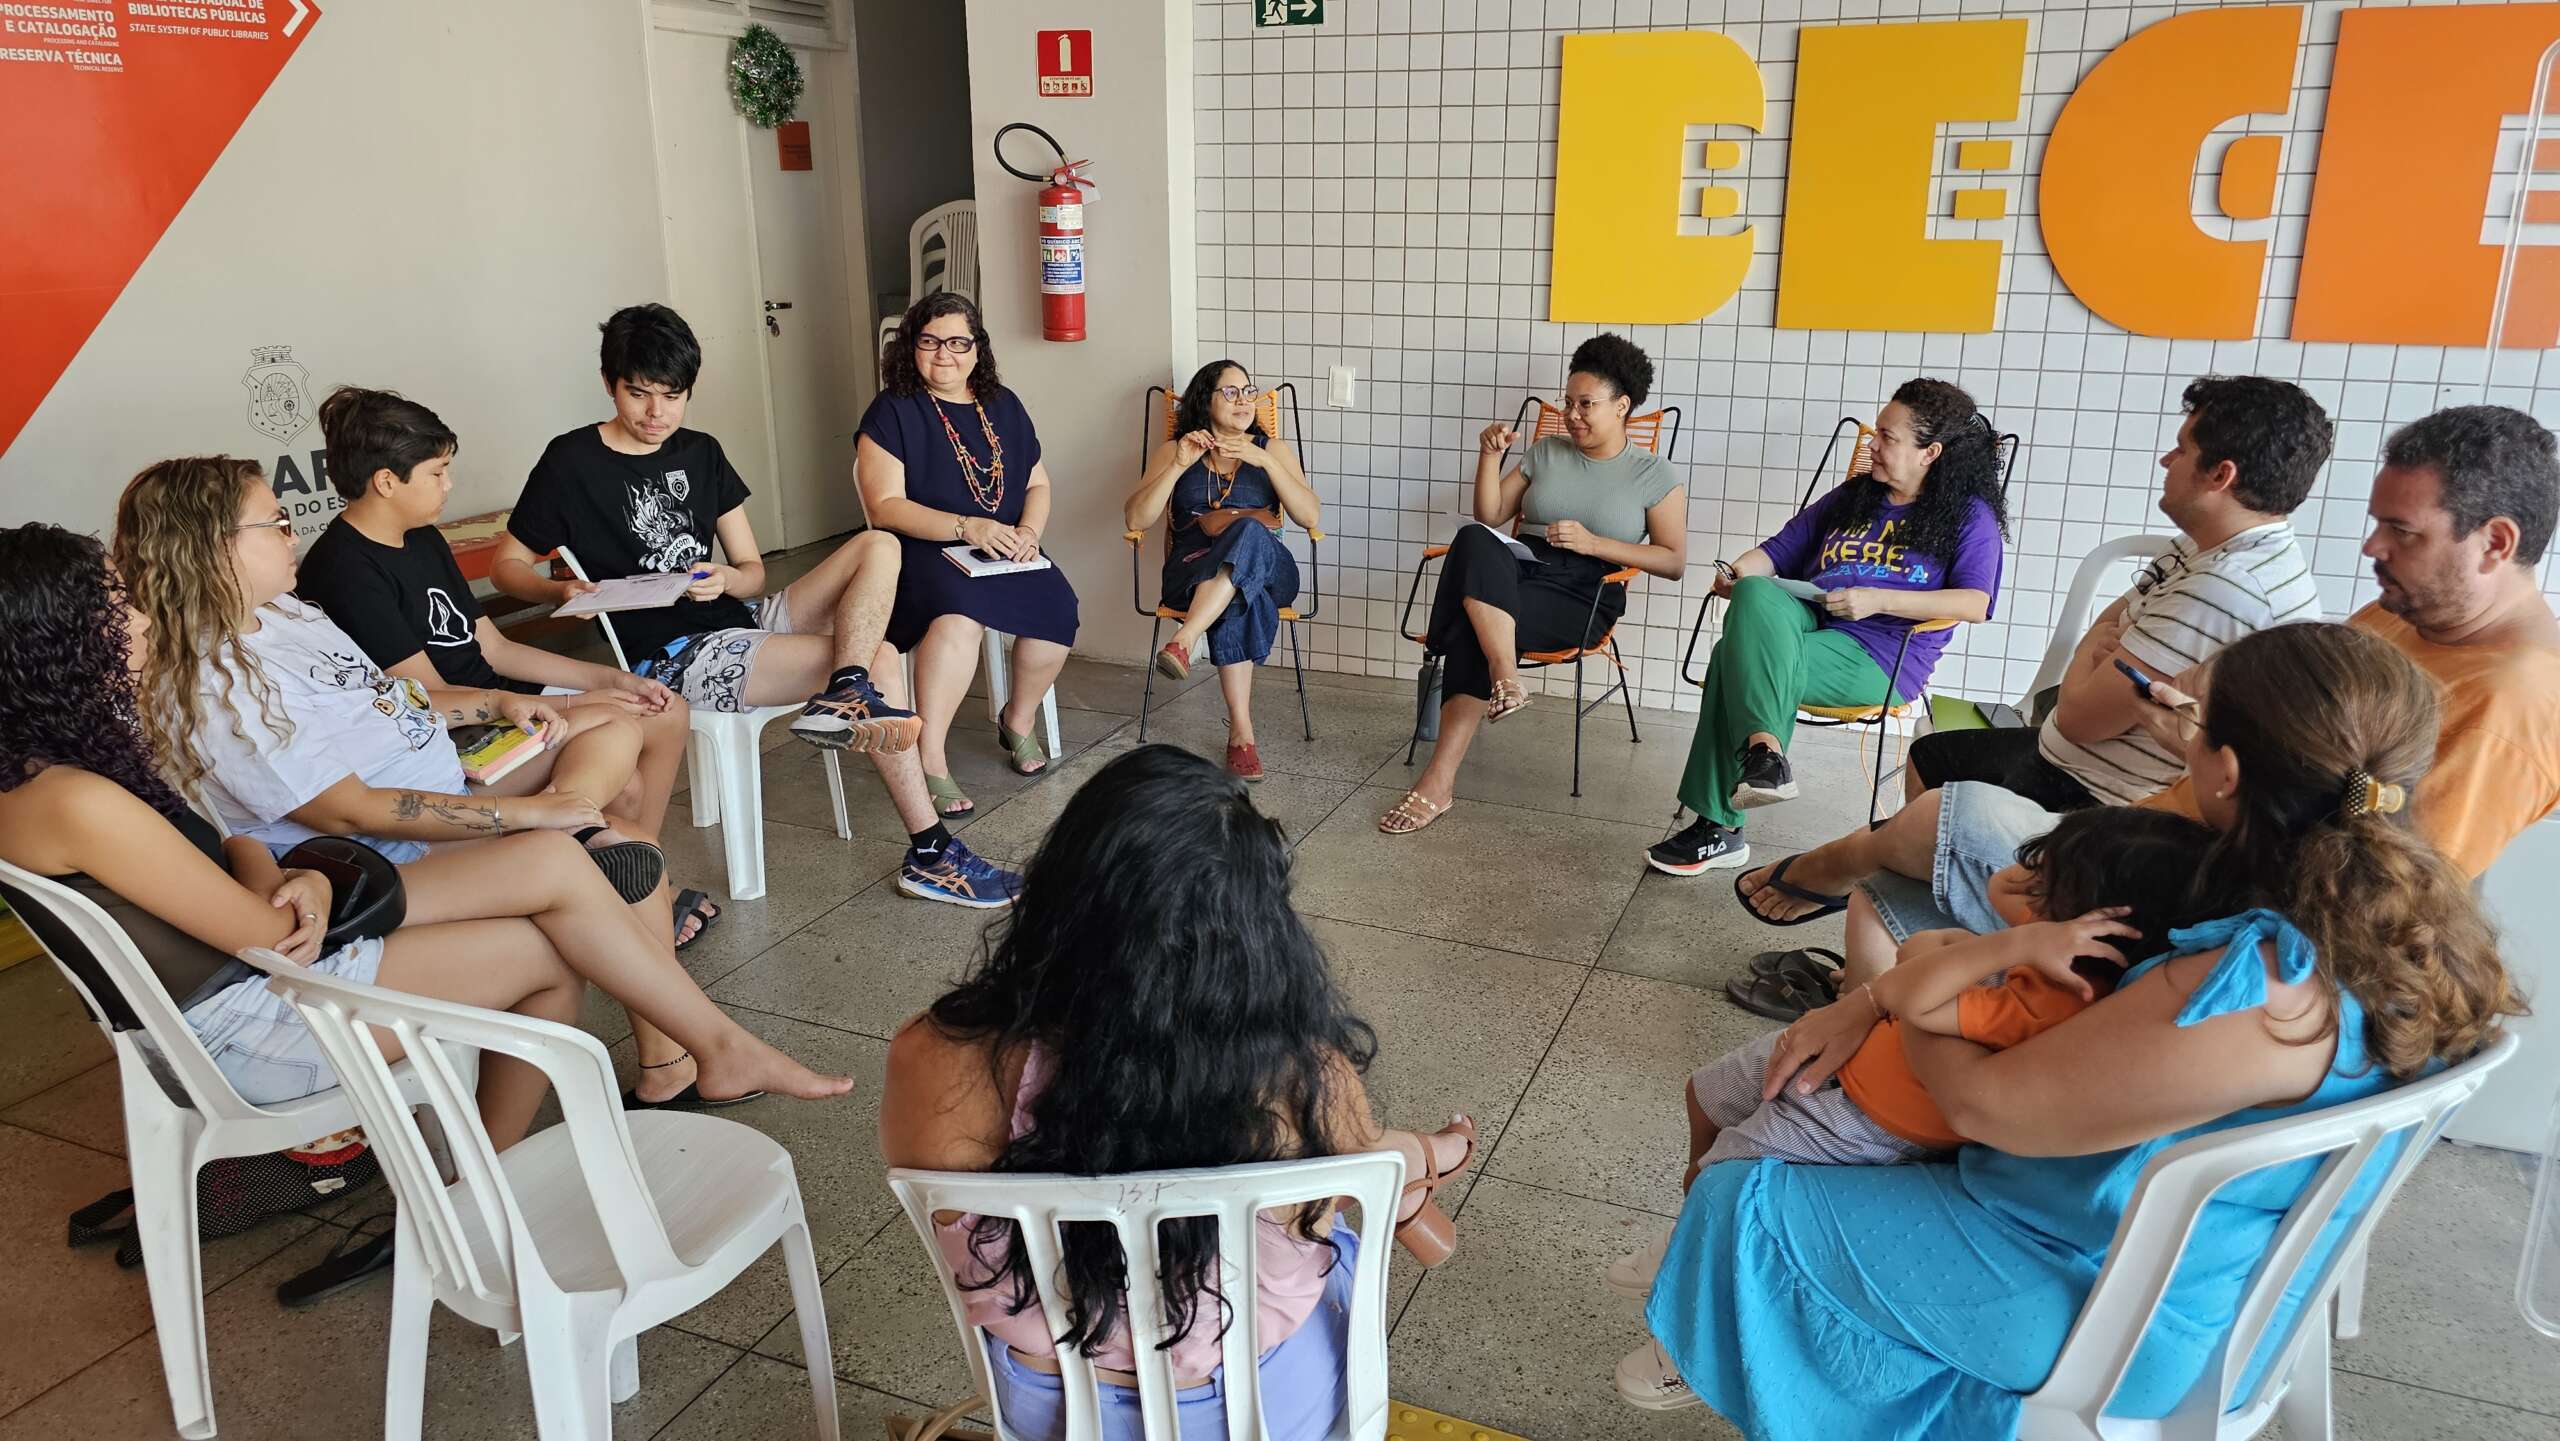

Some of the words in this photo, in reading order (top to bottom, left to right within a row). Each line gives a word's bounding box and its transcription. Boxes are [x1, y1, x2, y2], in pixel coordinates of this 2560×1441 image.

[128, 3, 207, 19] BIBLIOTECAS
[210, 7, 266, 23] PÚBLICAS
[5, 20, 15, 32] E
[18, 21, 117, 40] CATALOGAÇÃO
[130, 23, 156, 33] STATE
[158, 25, 189, 35] SYSTEM
[190, 27, 200, 36] OF
[202, 28, 229, 38] PUBLIC
[231, 30, 269, 40] LIBRARIES
[0, 48, 64, 63] RESERVA
[65, 49, 122, 65] TÉCNICA
[295, 500, 321, 517] DO
[1697, 840, 1728, 860] FILA
